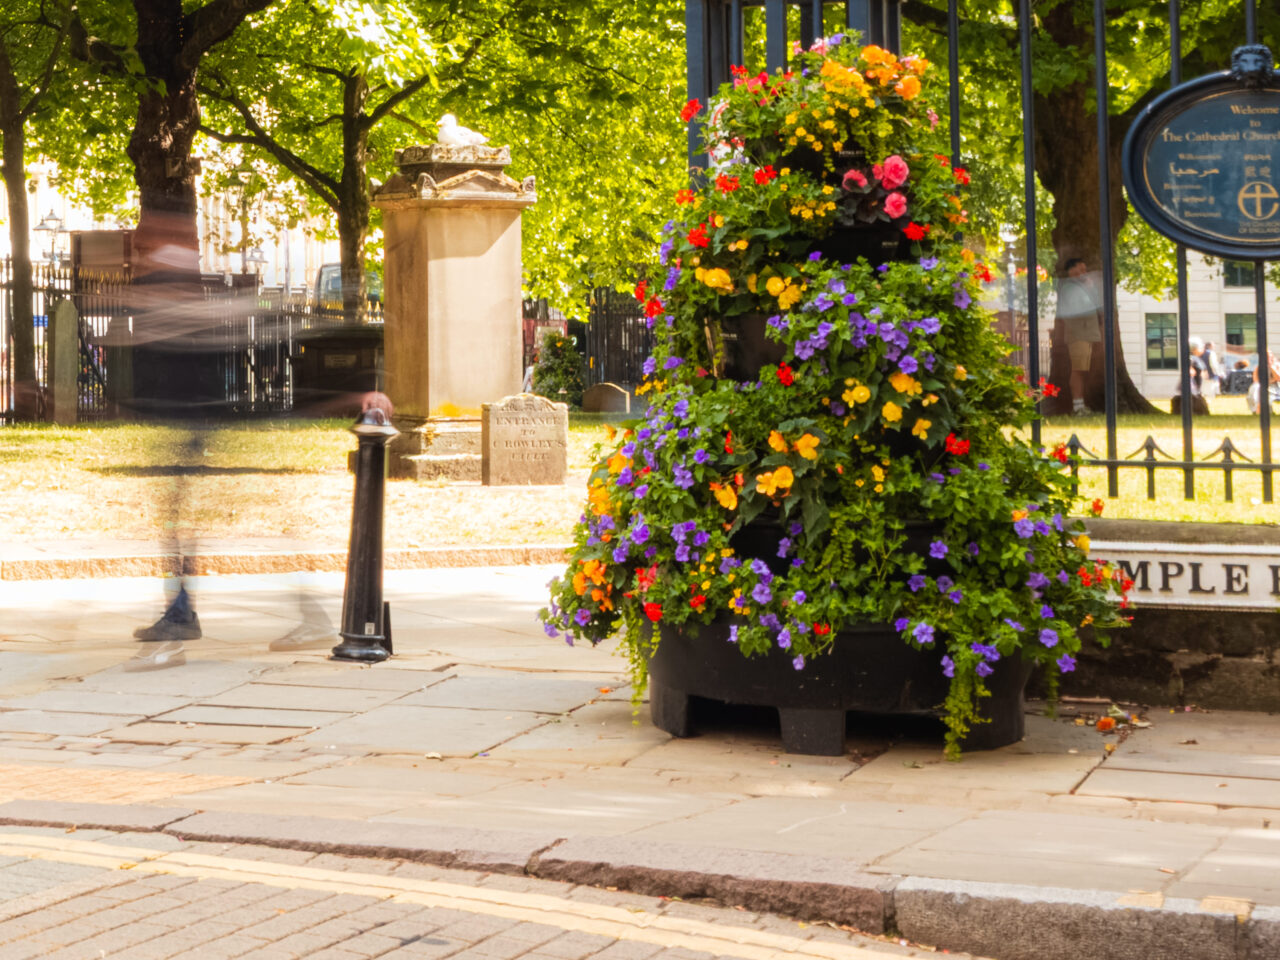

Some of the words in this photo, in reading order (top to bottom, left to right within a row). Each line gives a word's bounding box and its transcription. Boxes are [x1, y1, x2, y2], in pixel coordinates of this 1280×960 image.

[1231, 105, 1279, 115] Welcome
[1162, 128, 1183, 142] The
[1185, 131, 1240, 141] Cathedral
[1088, 559, 1250, 594] MPLE
